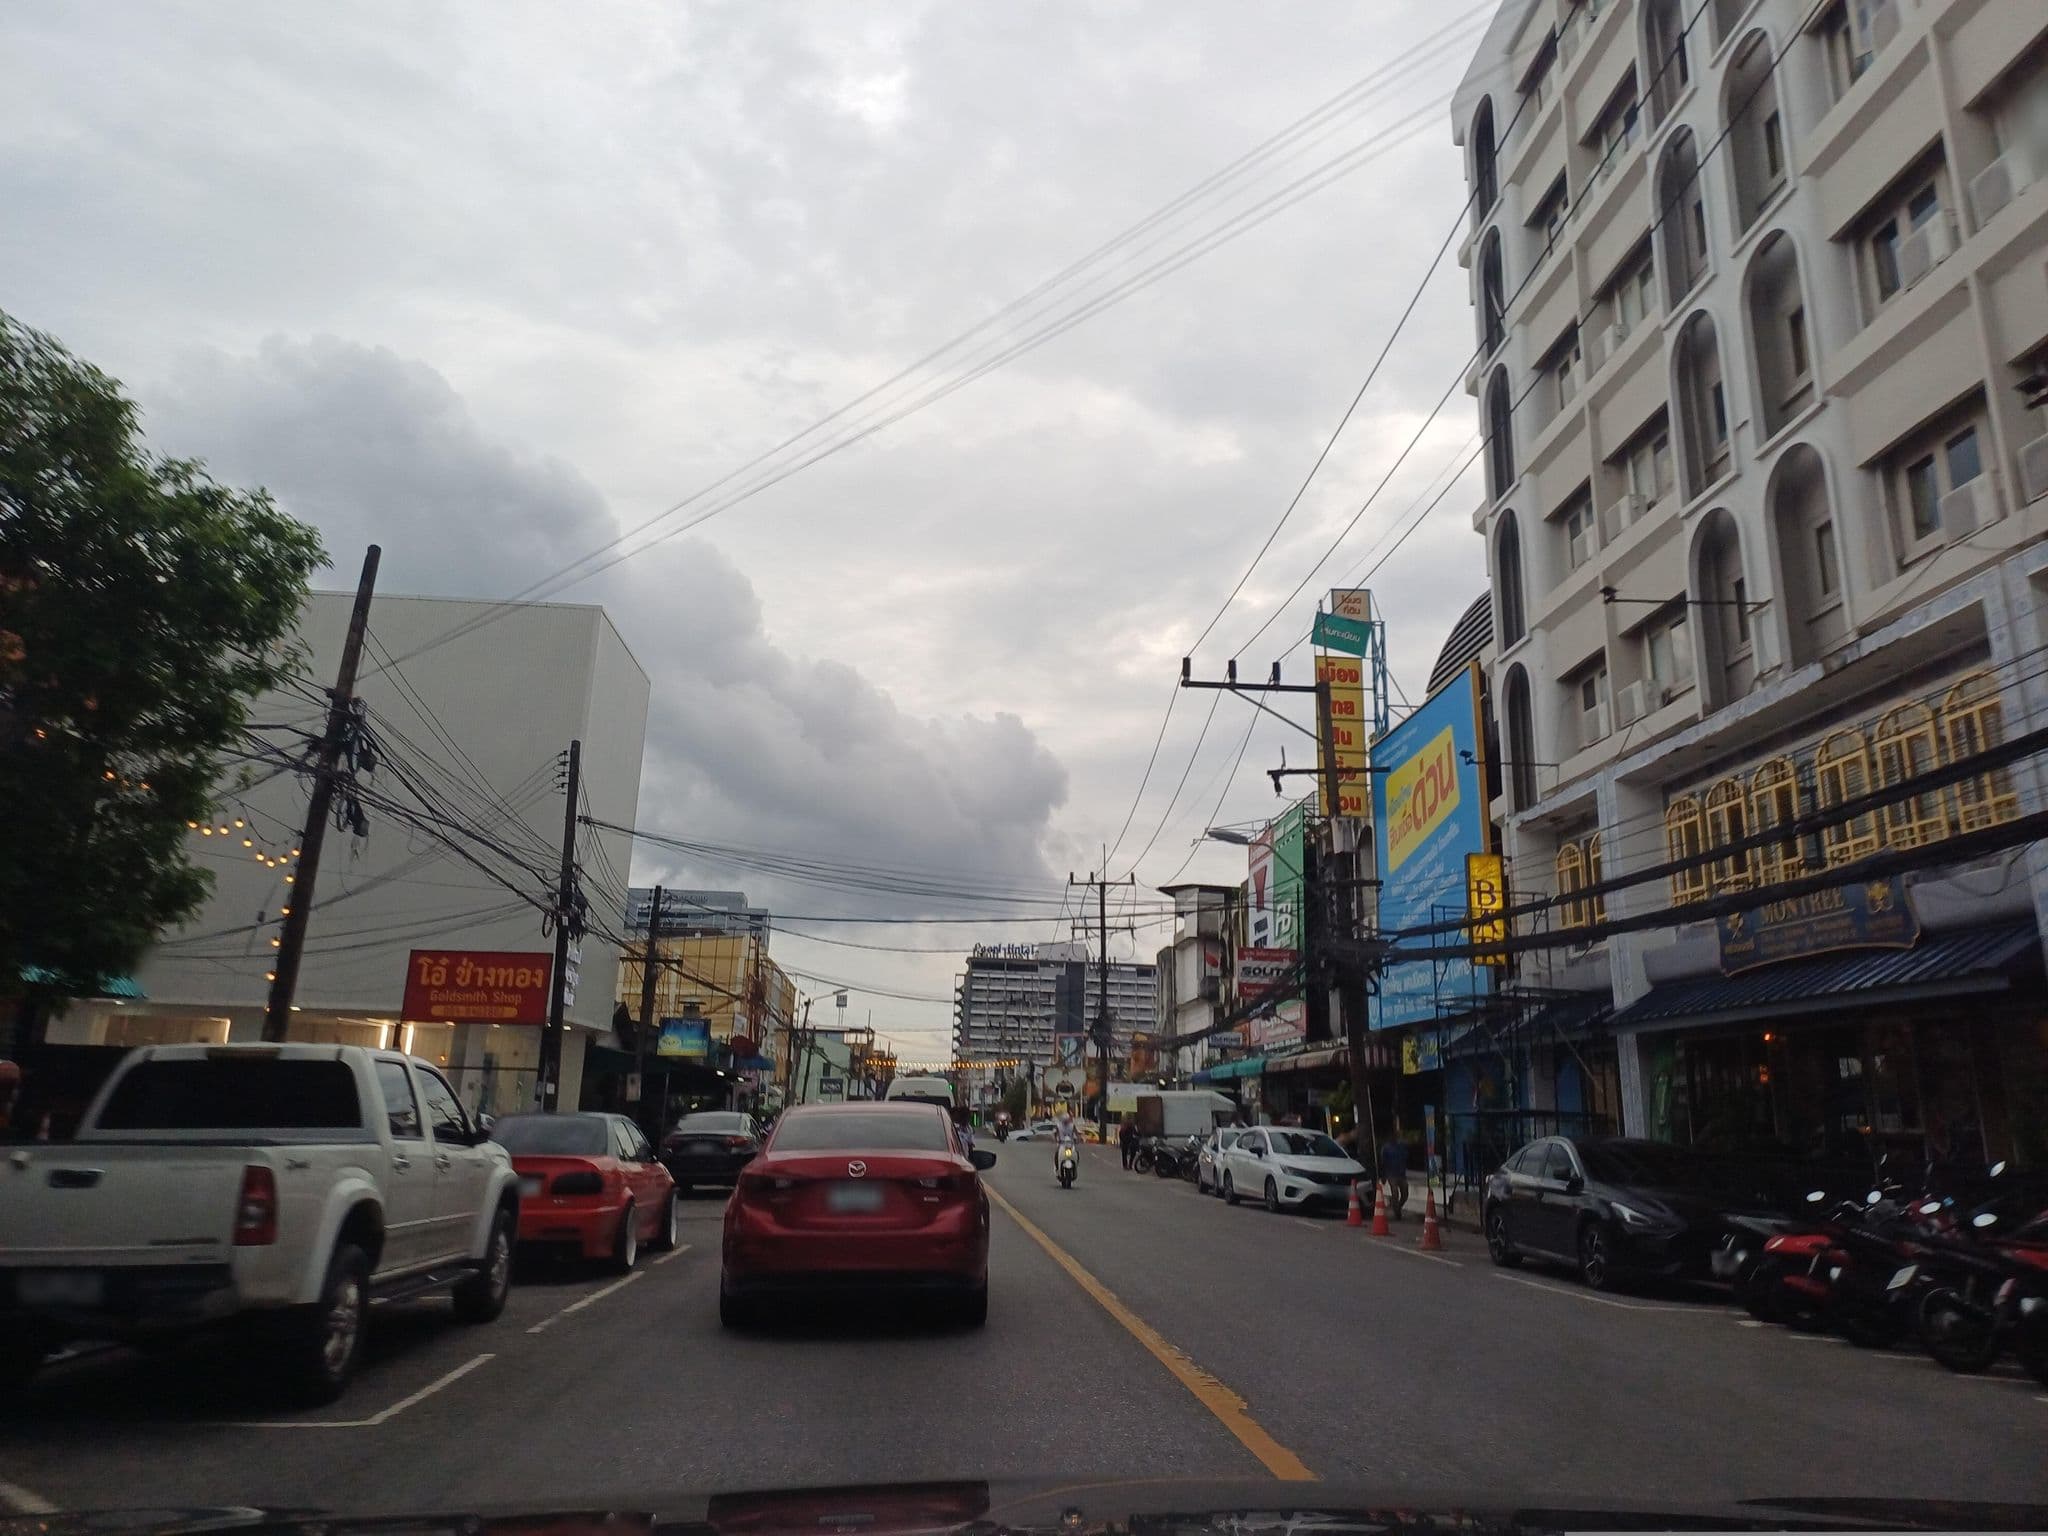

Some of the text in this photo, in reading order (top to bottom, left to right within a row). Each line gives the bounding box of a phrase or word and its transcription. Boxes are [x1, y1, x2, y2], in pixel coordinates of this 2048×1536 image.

[455, 956, 544, 989] ช่างทอง
[430, 989, 523, 1005] Goldsmith Shop
